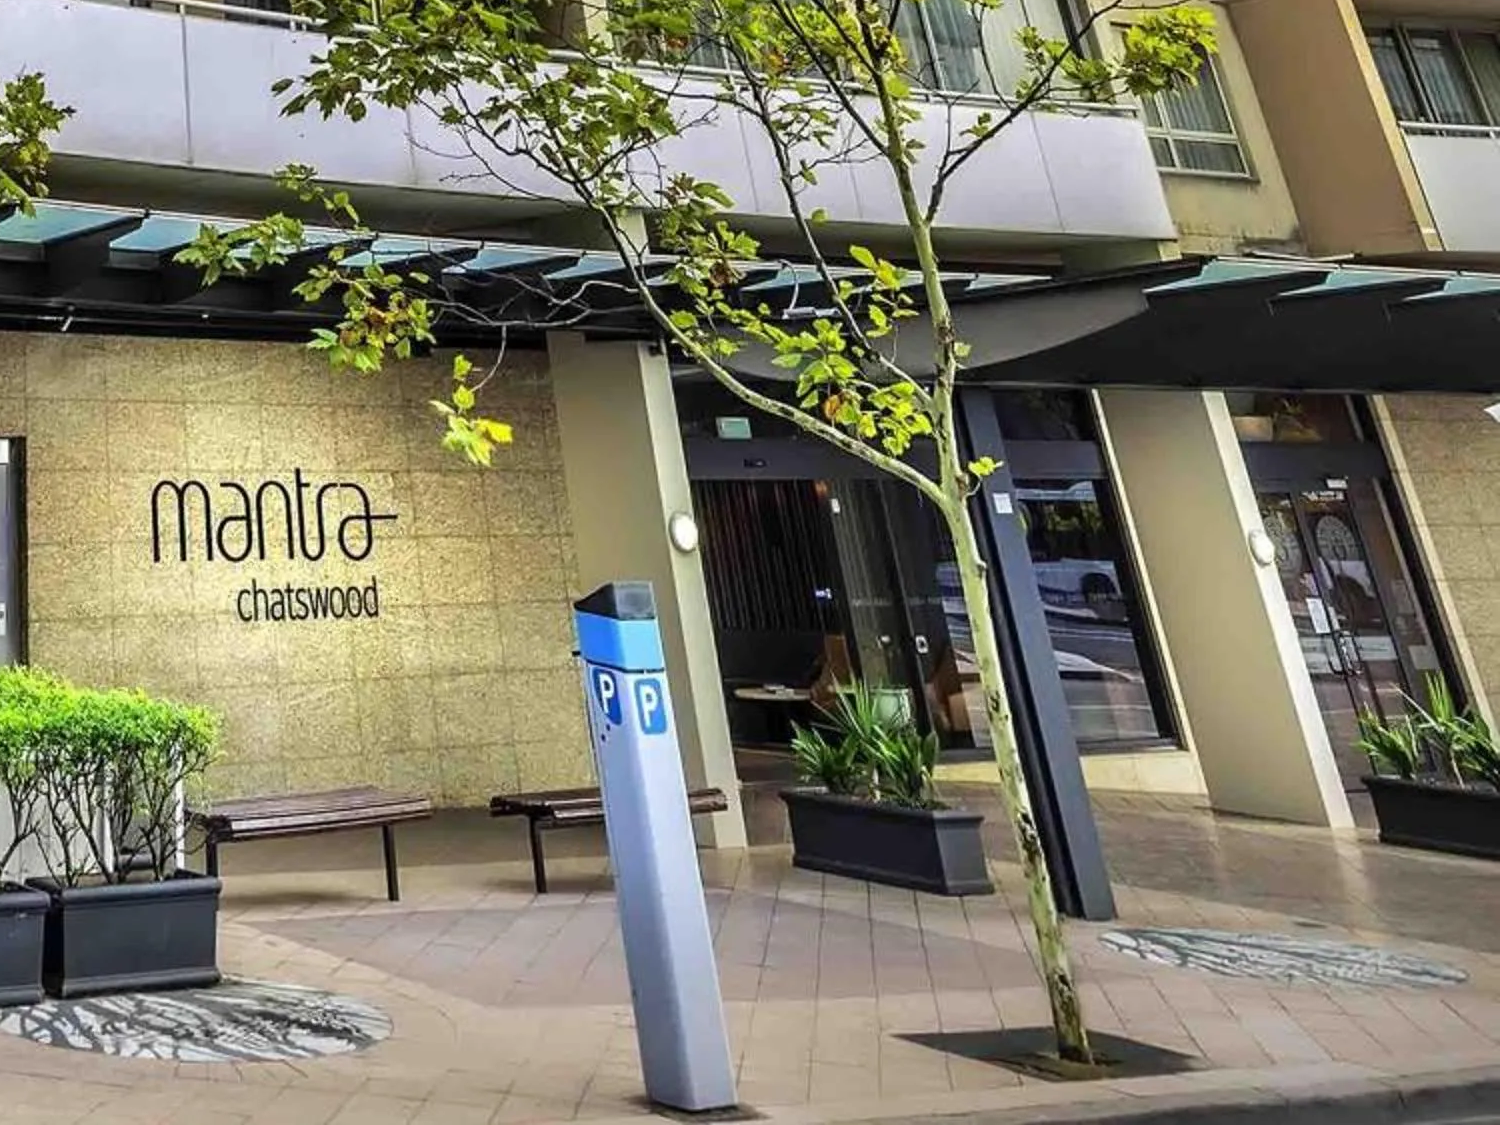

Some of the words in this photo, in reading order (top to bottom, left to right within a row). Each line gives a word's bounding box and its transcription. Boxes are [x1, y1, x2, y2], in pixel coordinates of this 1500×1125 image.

[151, 467, 398, 563] mantra
[237, 575, 380, 622] chatswood
[600, 673, 615, 715] P
[640, 683, 659, 729] P
